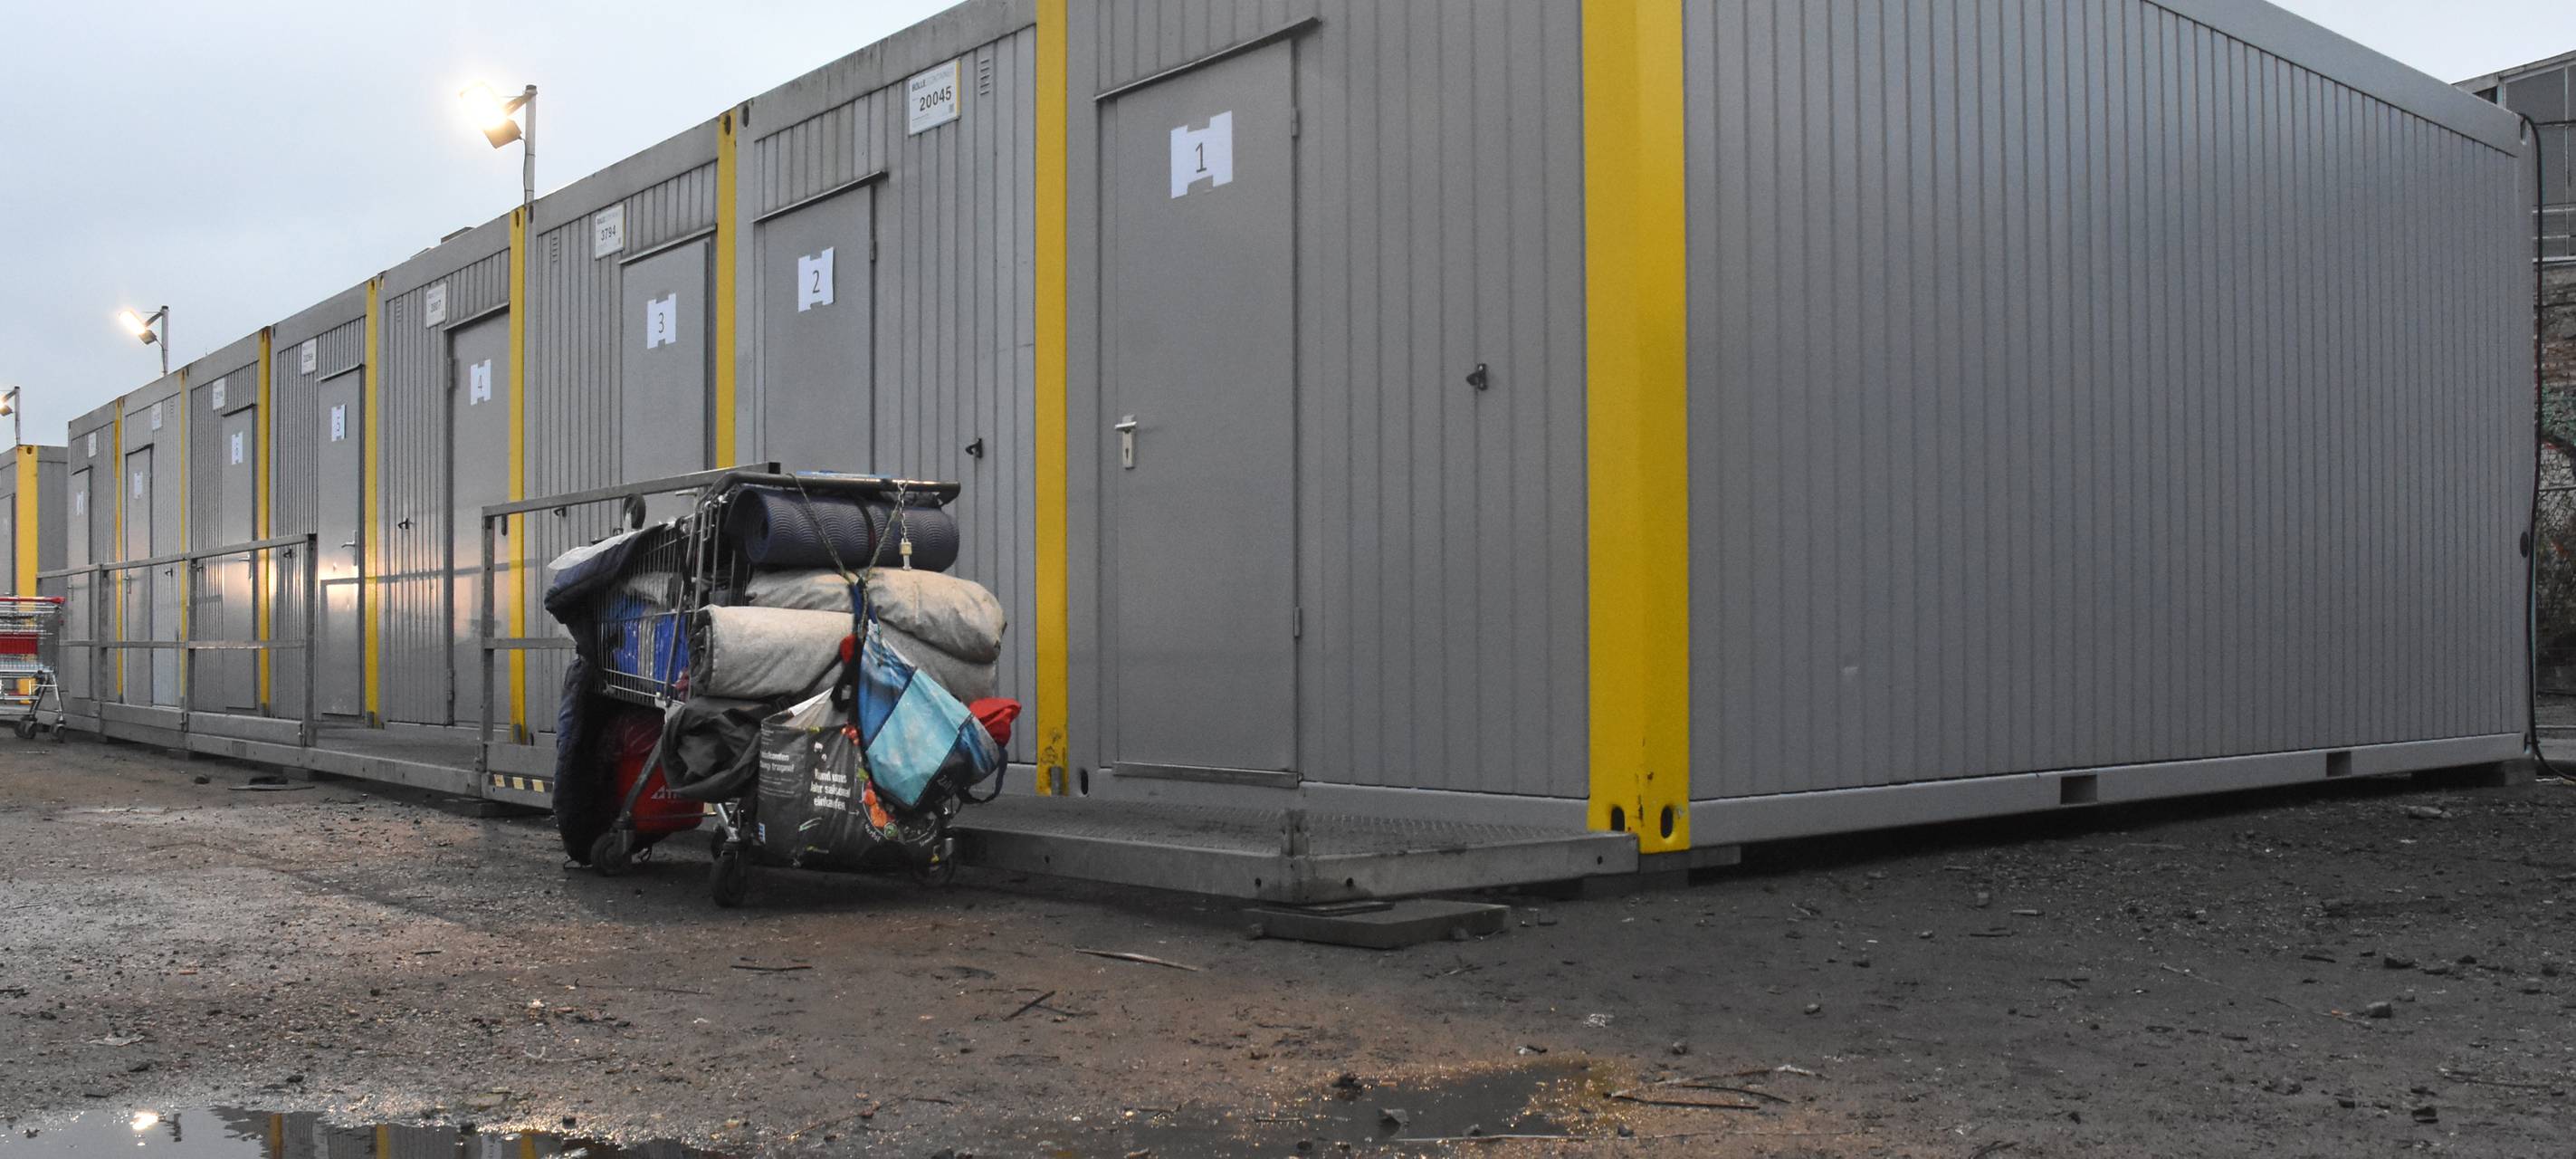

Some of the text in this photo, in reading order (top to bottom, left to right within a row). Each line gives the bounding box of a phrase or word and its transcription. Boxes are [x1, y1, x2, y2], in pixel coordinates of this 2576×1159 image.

[919, 85, 952, 111] 20045
[1195, 141, 1207, 174] 1
[600, 225, 616, 241] 3794
[812, 269, 821, 294] 2
[658, 311, 664, 334] 3
[477, 374, 482, 392] 4
